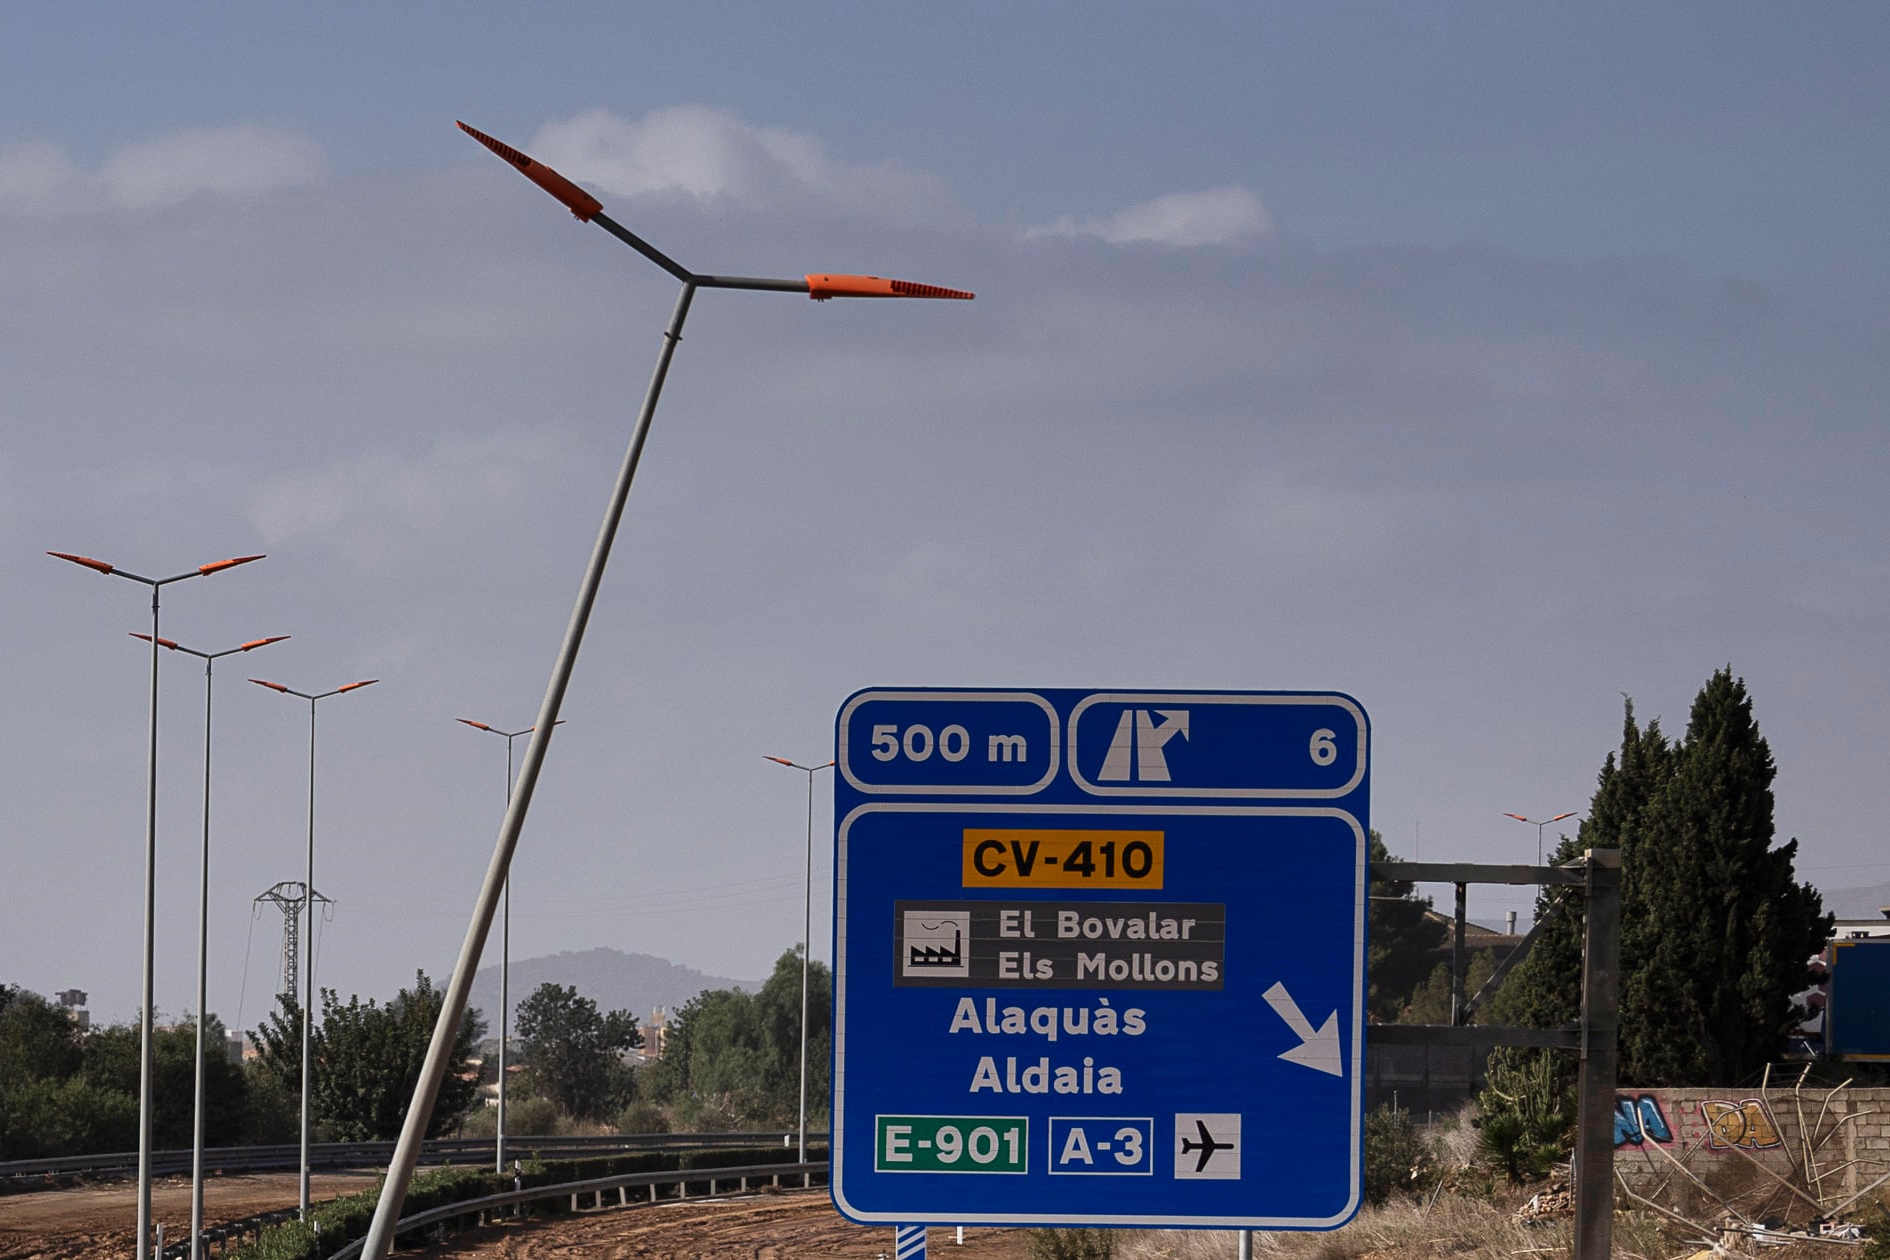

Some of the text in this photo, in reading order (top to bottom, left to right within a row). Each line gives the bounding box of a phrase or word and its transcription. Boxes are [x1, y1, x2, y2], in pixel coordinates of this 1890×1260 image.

[871, 724, 1027, 762] 500 m
[1309, 728, 1337, 766] 6
[973, 839, 1153, 879] CV-410
[999, 910, 1196, 940] El Bovalar
[998, 951, 1218, 982] Els Mollons
[948, 997, 1146, 1042] Alaquàs
[969, 1056, 1124, 1095] Aldaia
[885, 1125, 1019, 1164] E-901
[1059, 1127, 1143, 1166] A-3
